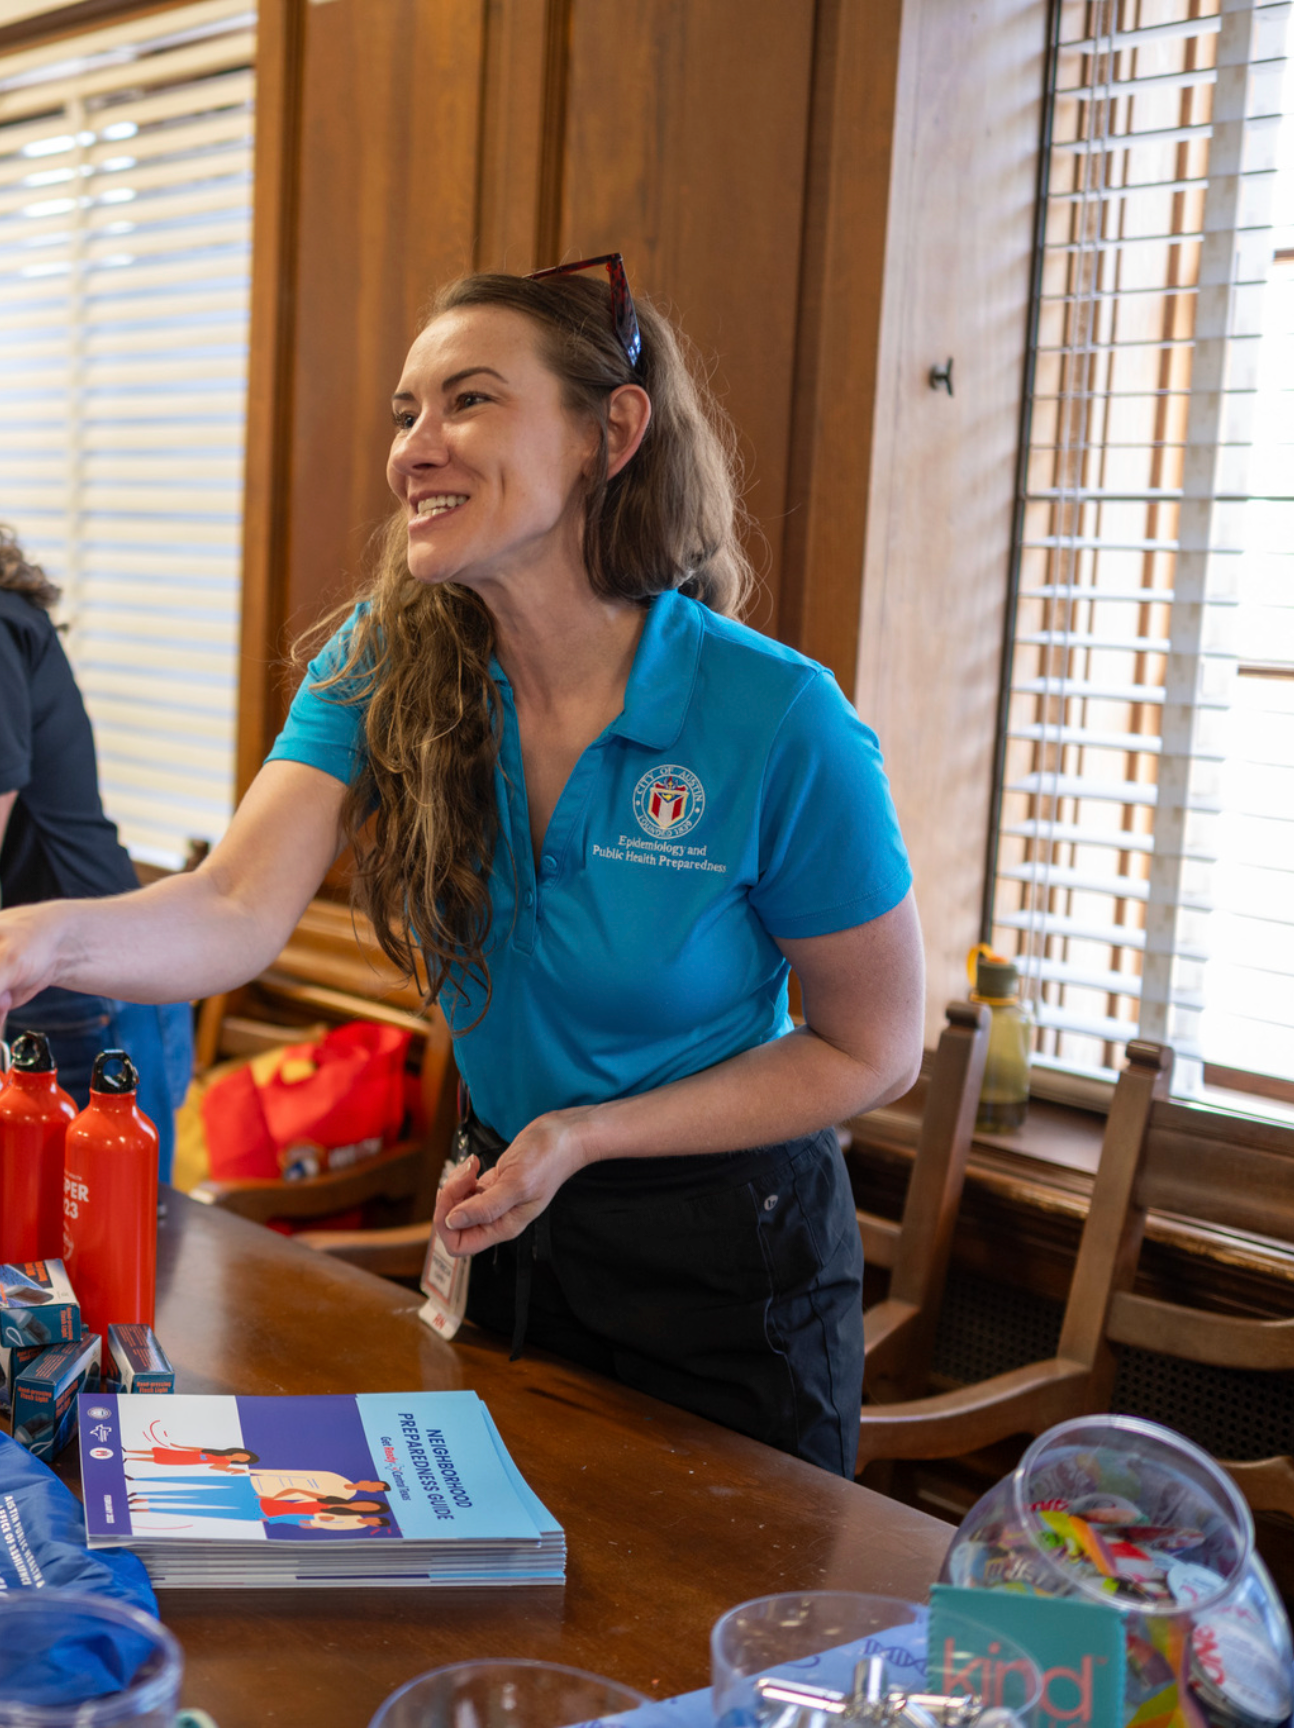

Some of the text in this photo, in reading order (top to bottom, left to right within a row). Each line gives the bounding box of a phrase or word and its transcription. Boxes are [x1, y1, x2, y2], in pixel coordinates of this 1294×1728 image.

[636, 766, 703, 802] CITY OF AUSTIN
[593, 844, 727, 873] Public Health Preparedness
[618, 835, 707, 857] Epidemiology and
[64, 1177, 90, 1203] PER
[63, 1198, 79, 1220] 23
[380, 1436, 392, 1447] Get
[384, 1446, 398, 1463] Ready
[398, 1413, 455, 1520] PREPAREDNESS GUIDE
[426, 1429, 473, 1508] NEIGHBORHOOD
[942, 1637, 1093, 1722] kind
